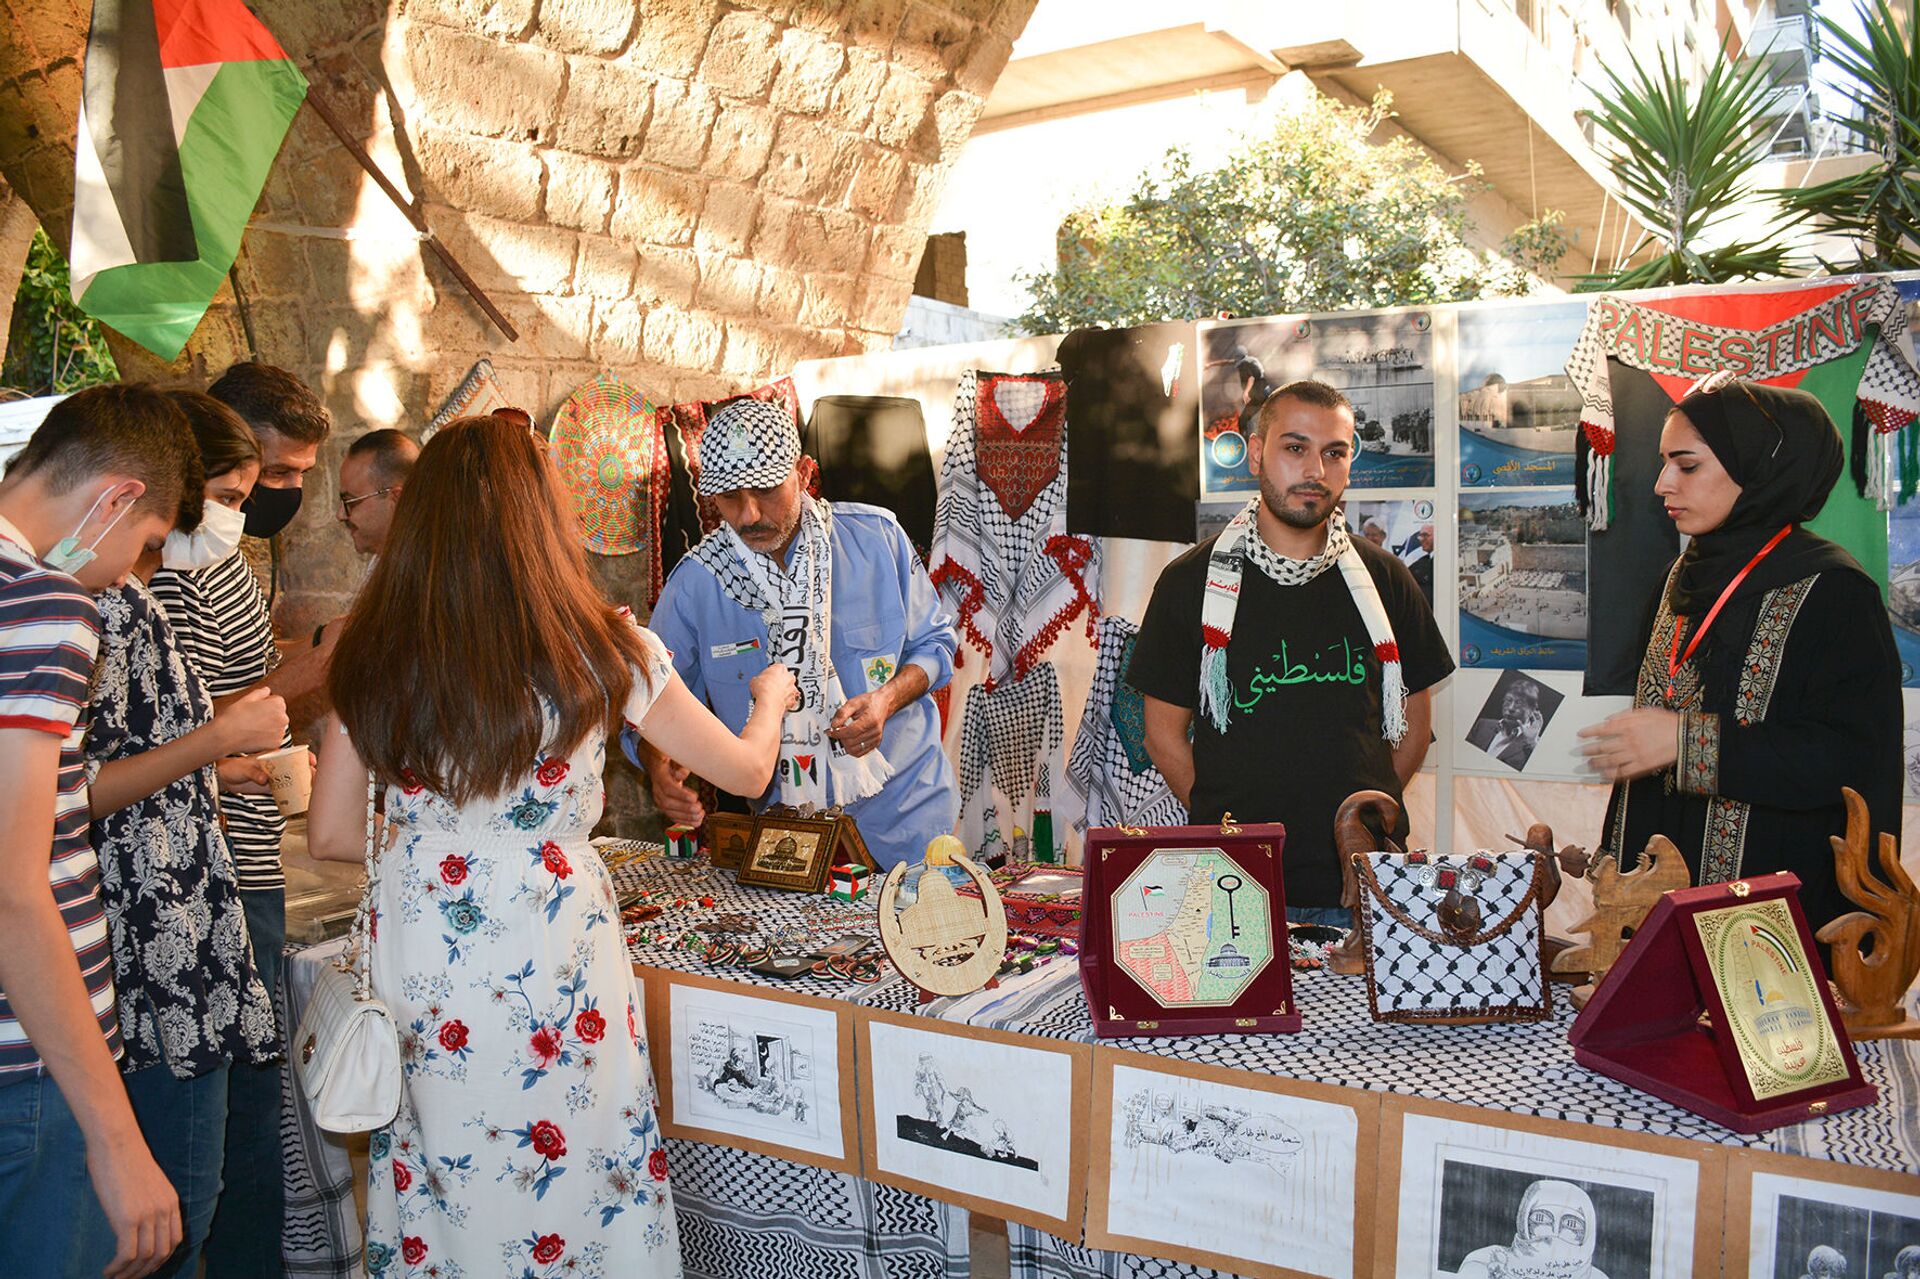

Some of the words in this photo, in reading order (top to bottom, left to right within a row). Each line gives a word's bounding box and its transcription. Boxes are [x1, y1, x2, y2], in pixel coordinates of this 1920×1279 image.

[1492, 459, 1520, 475] الأقصى
[1524, 459, 1557, 472] المسجد
[781, 720, 821, 747] فلسط
[1751, 939, 1788, 976] PALESTINE
